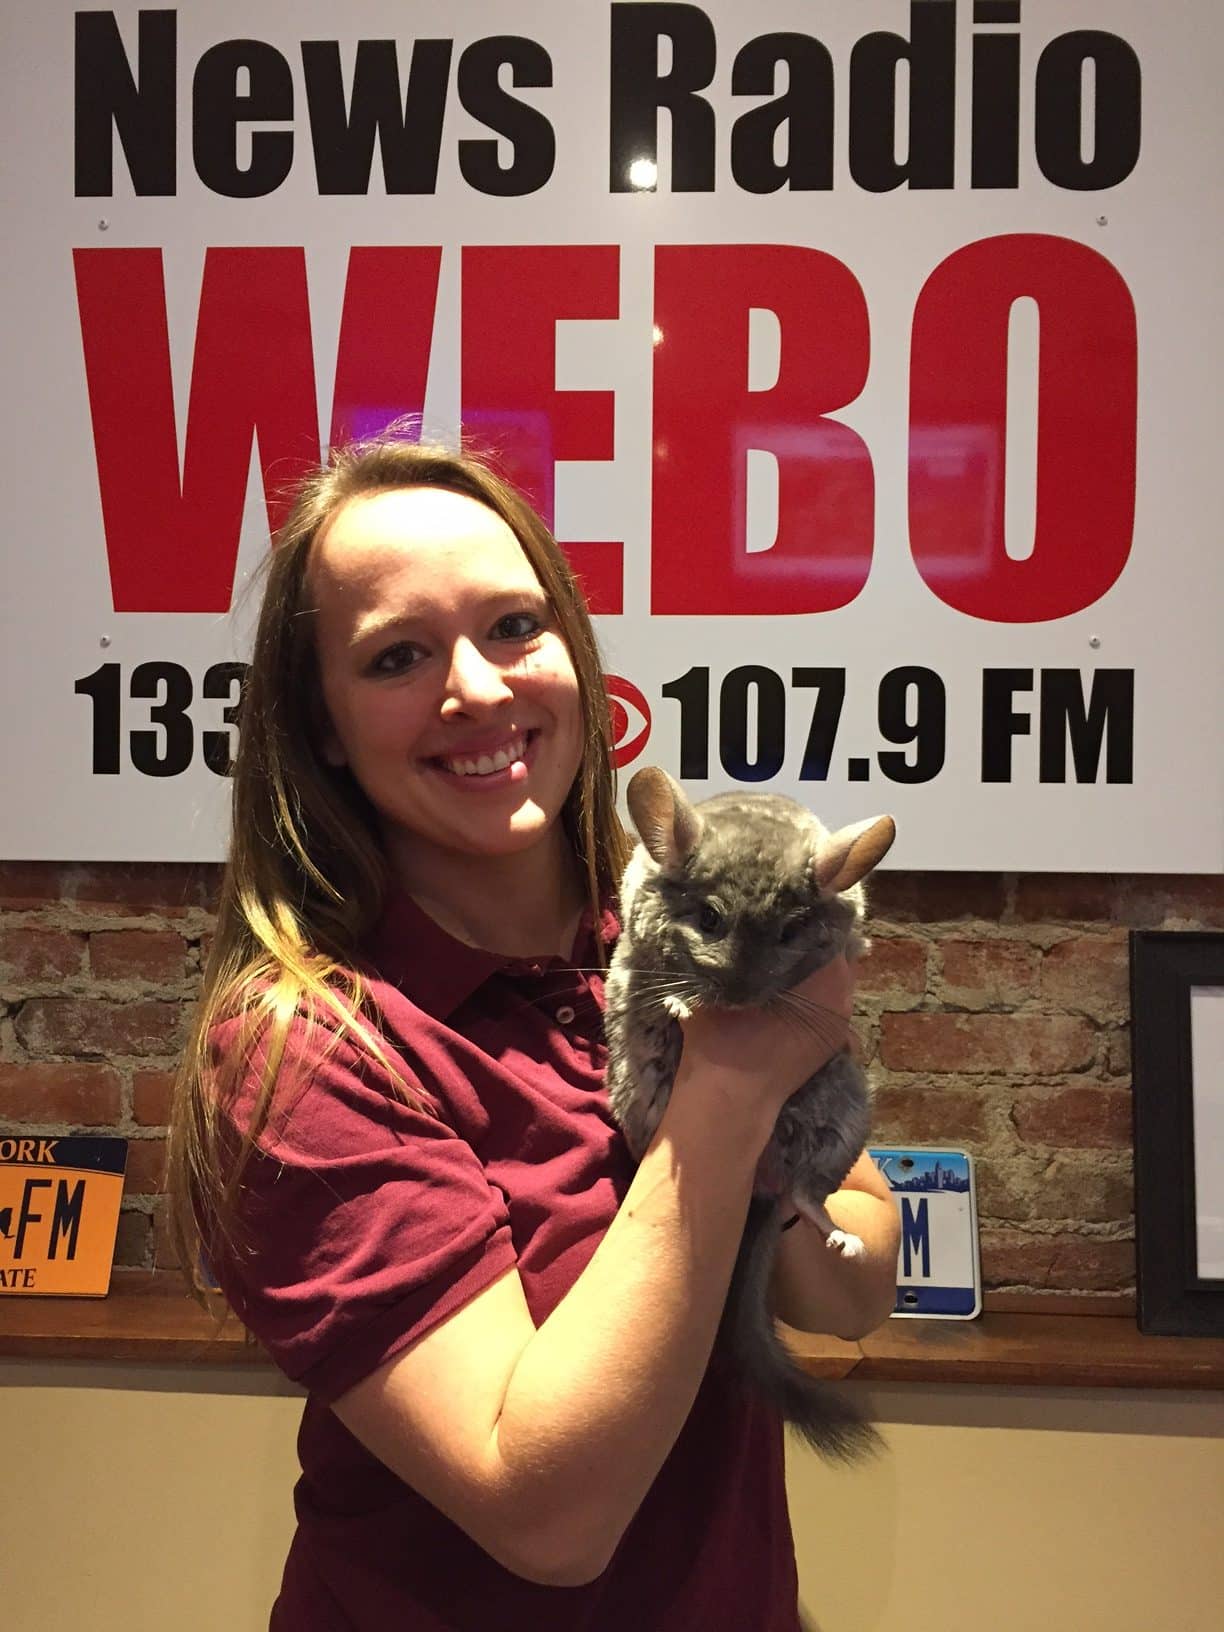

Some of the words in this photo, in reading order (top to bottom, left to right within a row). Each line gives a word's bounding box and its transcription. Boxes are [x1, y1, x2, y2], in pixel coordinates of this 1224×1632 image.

[74, 9, 556, 198] News
[610, 0, 1141, 194] Radio
[72, 233, 1138, 624] WEBO
[662, 665, 946, 784] 107.9
[981, 668, 1135, 784] FM
[13, 1179, 86, 1260] FM
[901, 1197, 930, 1278] M
